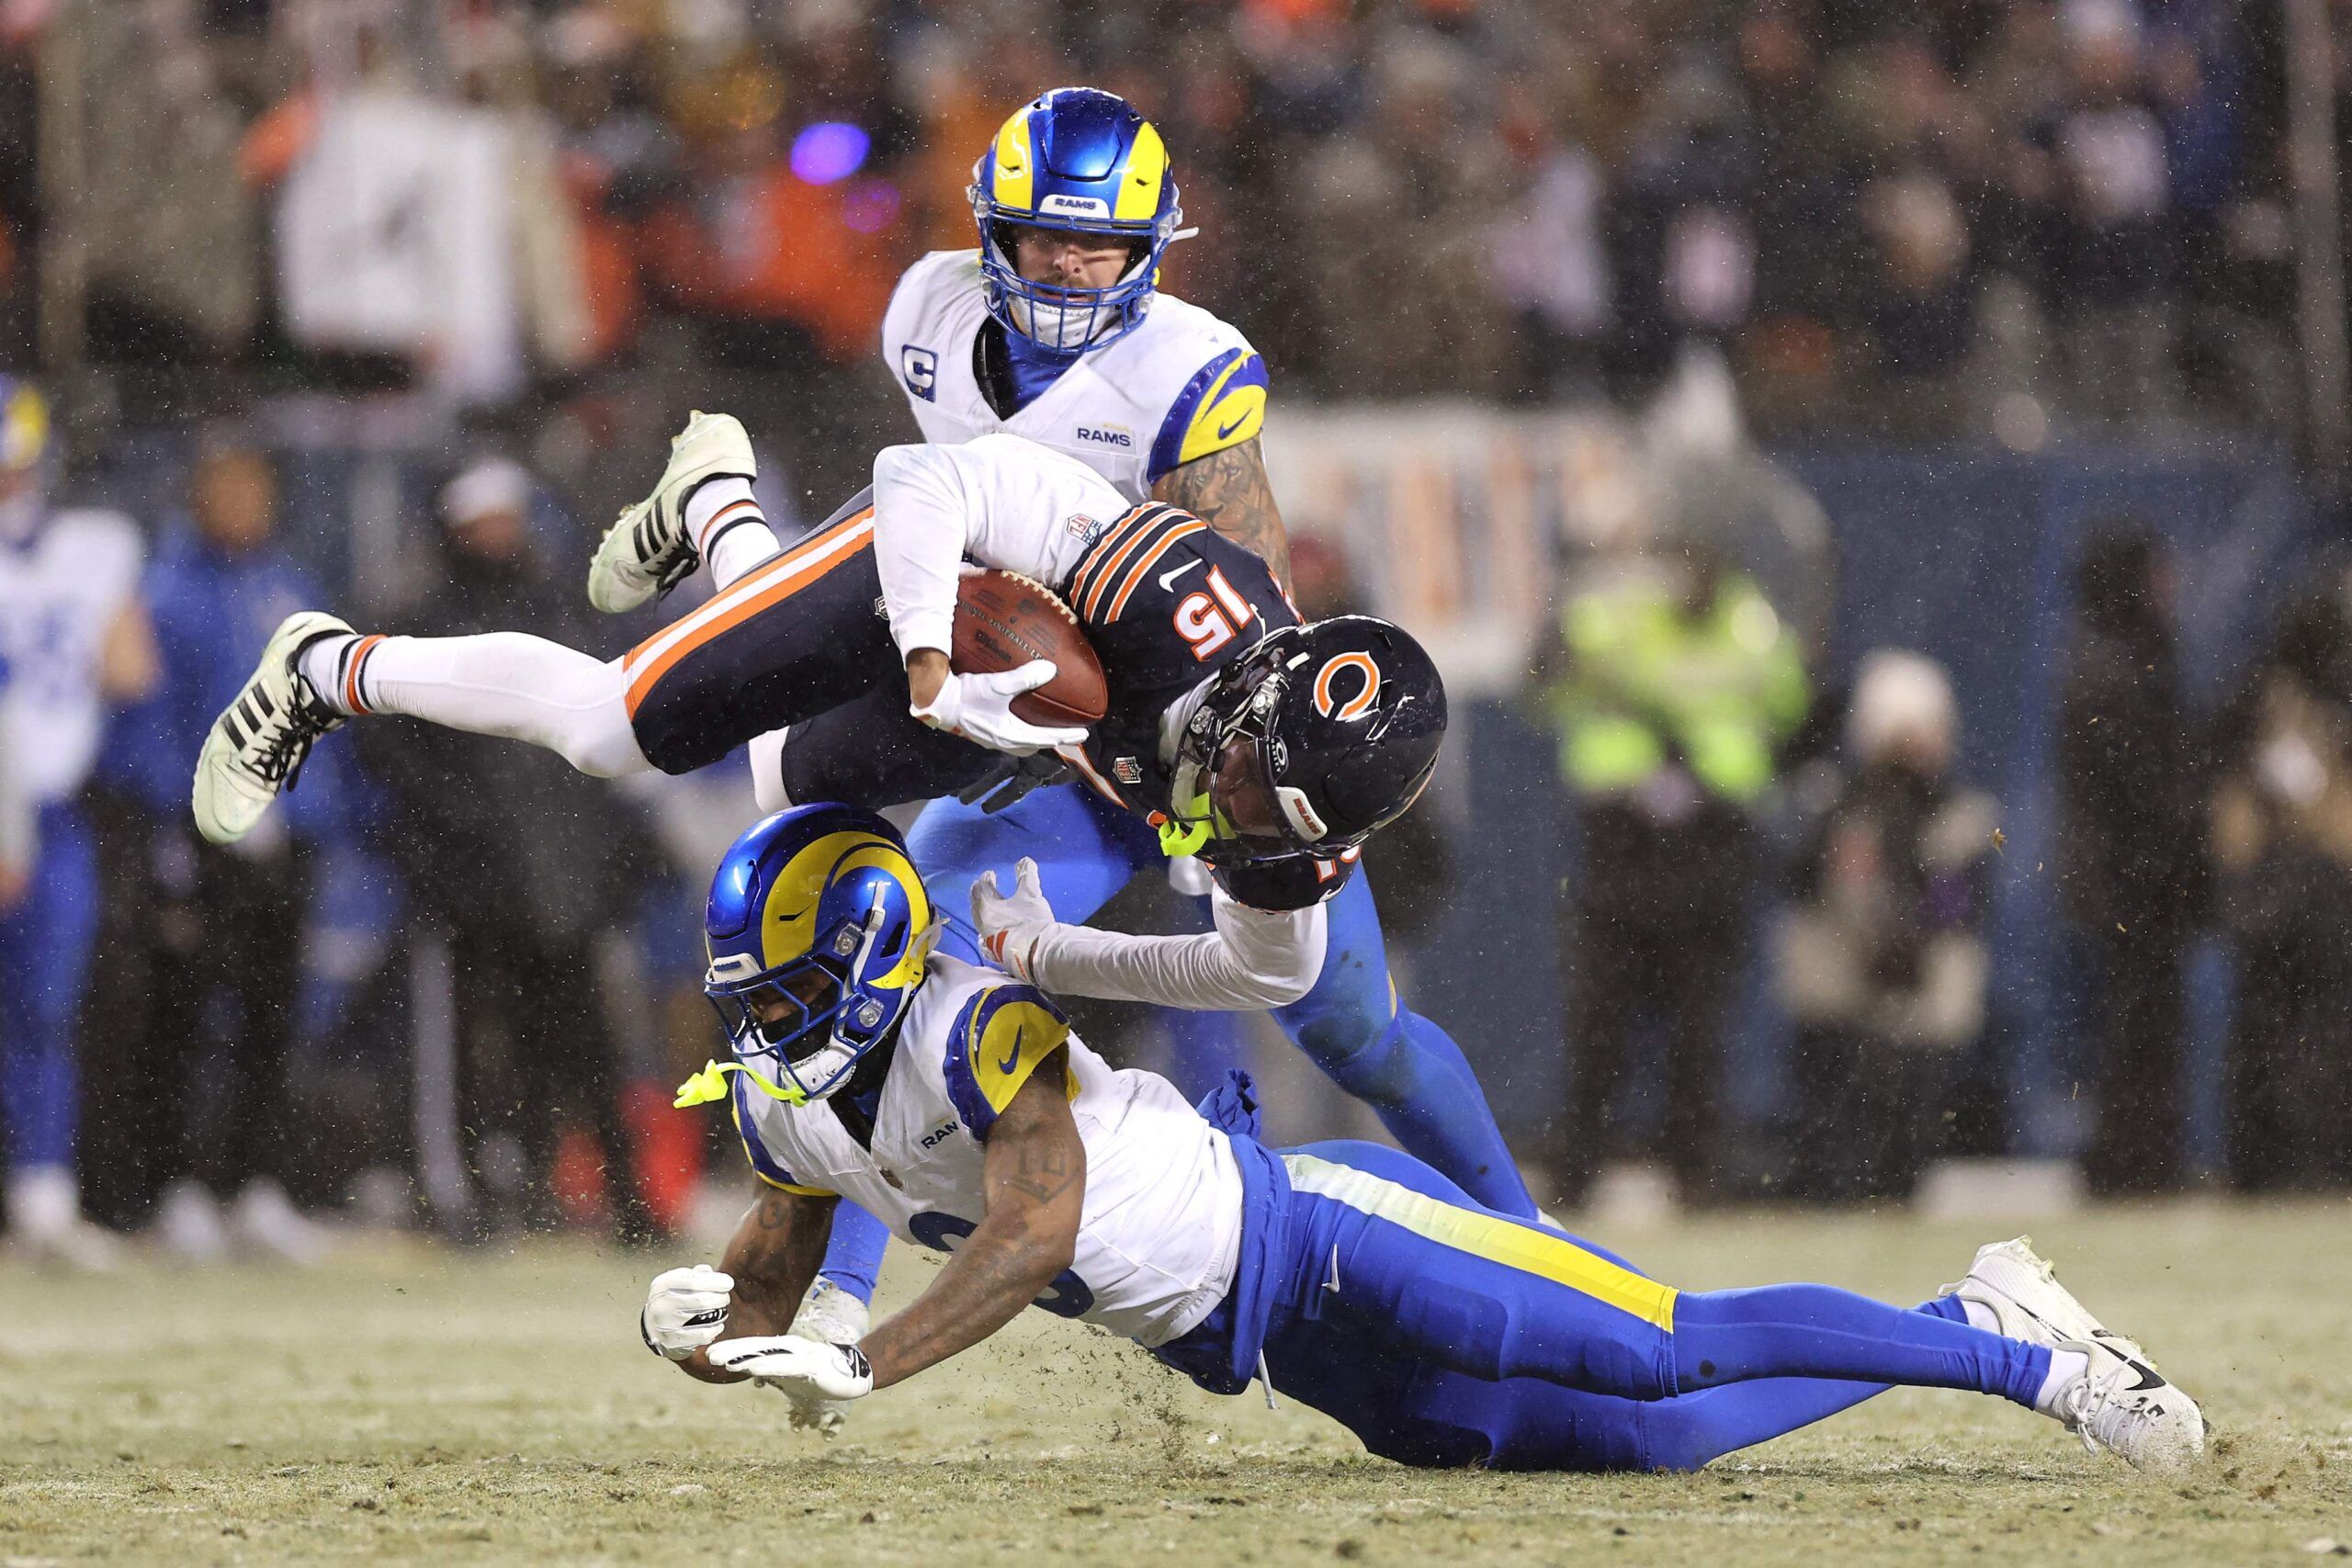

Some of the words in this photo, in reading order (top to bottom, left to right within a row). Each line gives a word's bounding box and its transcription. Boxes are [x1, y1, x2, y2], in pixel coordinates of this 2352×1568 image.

[1055, 197, 1097, 210] RAMS
[904, 349, 934, 389] C
[1077, 427, 1131, 447] RAMS
[1172, 563, 1255, 662] 15
[1294, 797, 1320, 835] BEARS
